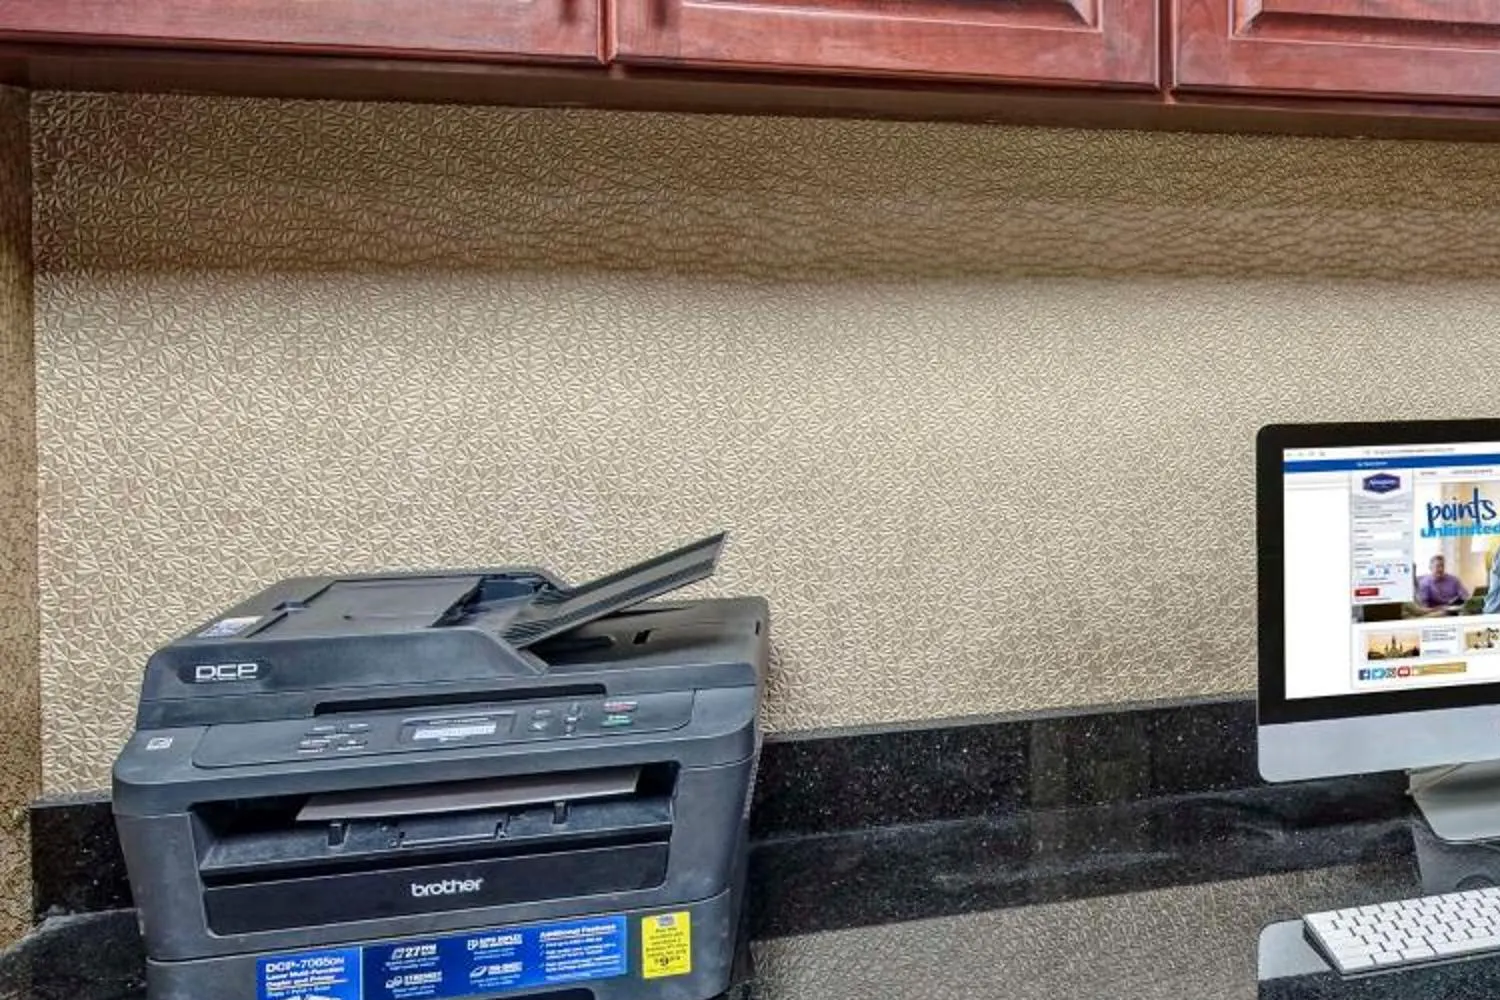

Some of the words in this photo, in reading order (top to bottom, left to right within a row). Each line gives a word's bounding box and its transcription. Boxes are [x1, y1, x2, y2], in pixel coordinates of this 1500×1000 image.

[1426, 486, 1498, 529] points
[195, 662, 259, 681] DCP
[411, 877, 484, 897] brother
